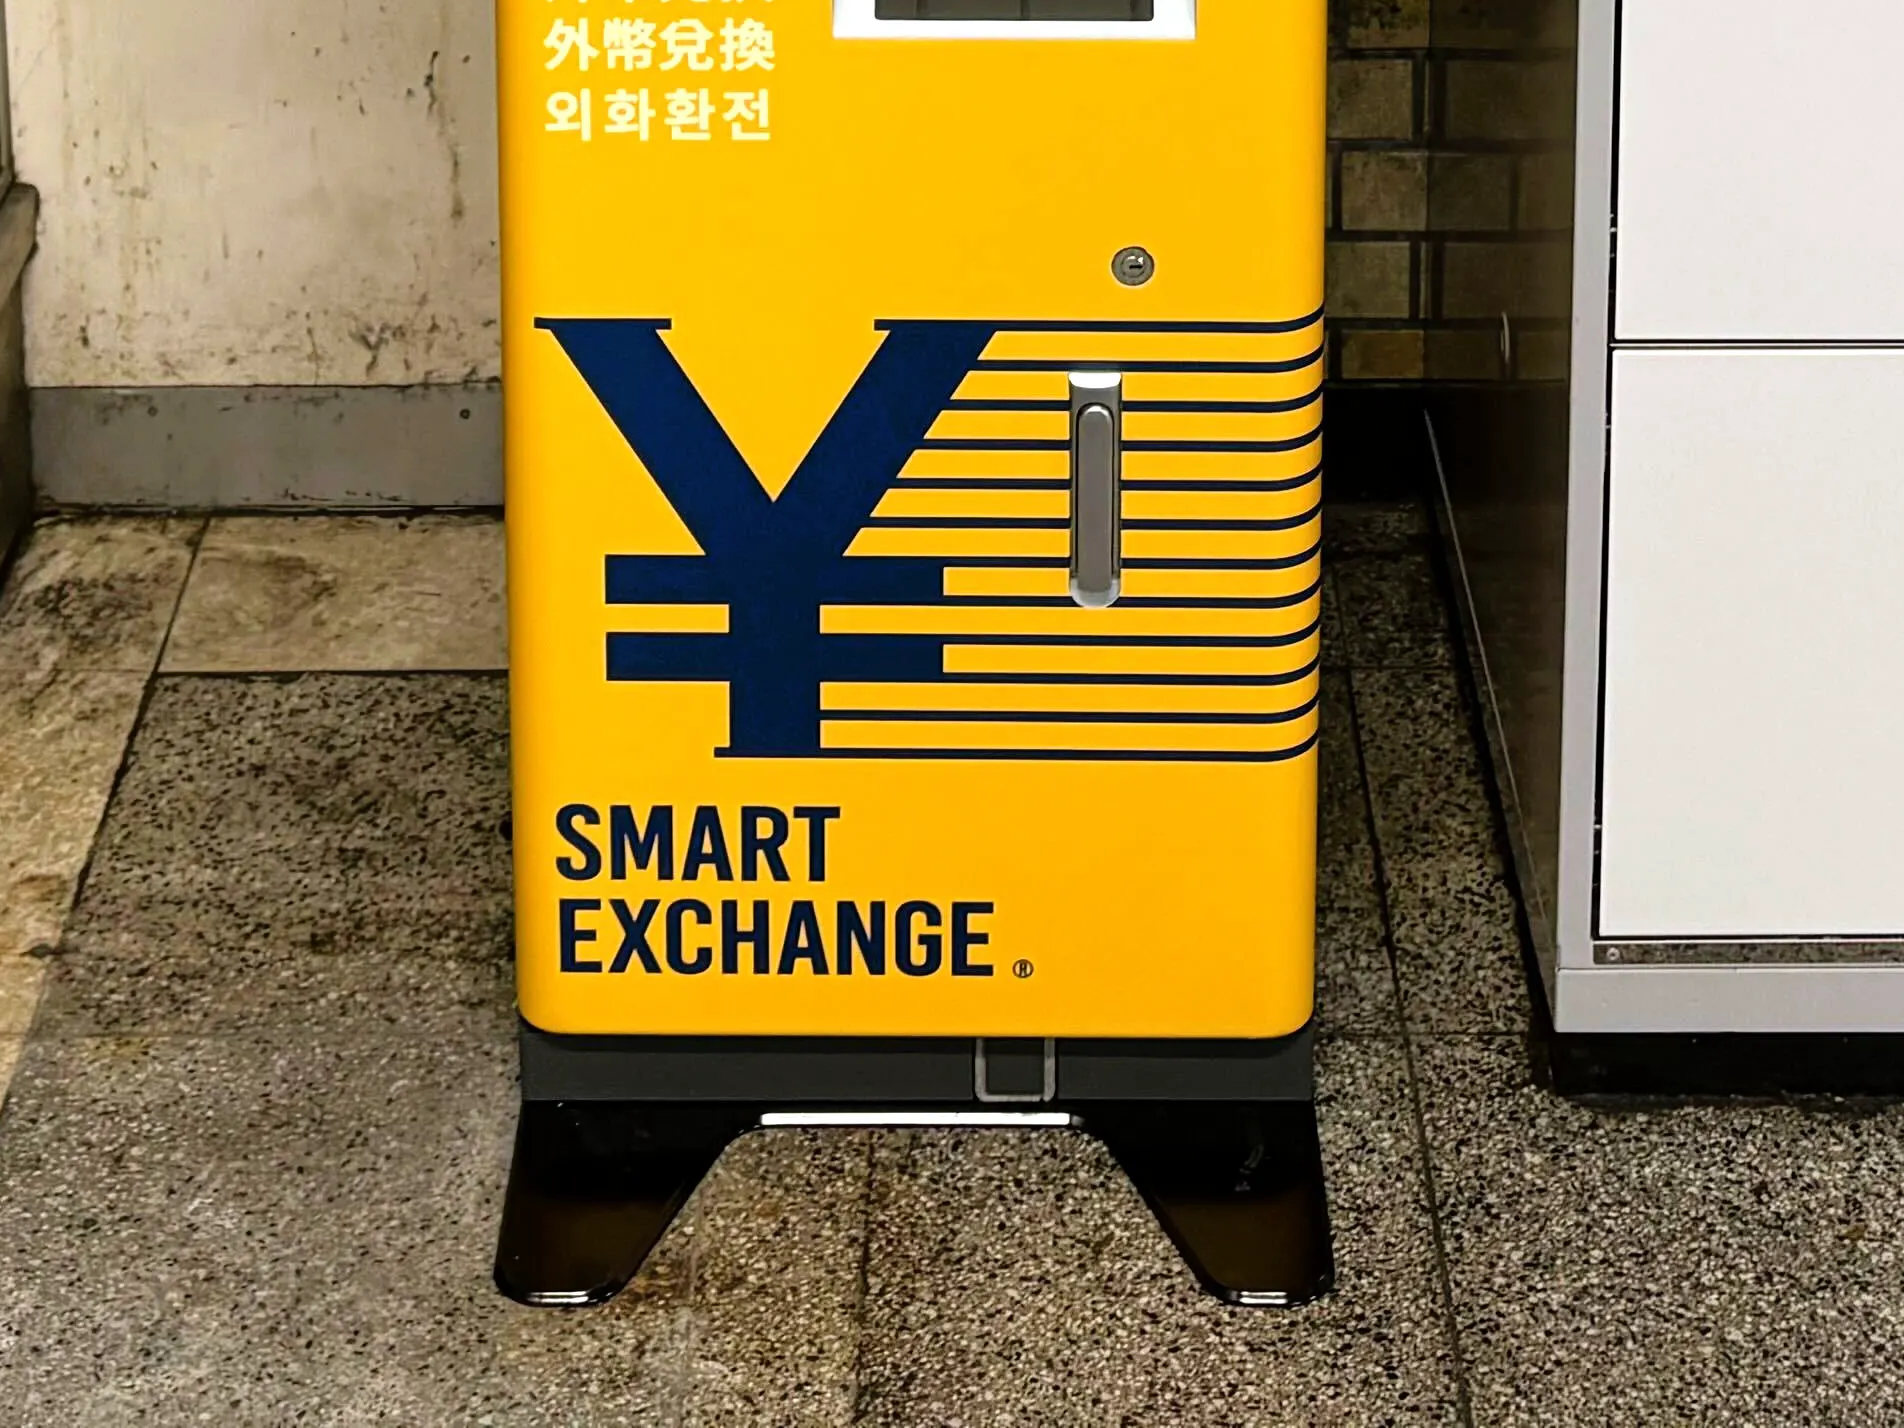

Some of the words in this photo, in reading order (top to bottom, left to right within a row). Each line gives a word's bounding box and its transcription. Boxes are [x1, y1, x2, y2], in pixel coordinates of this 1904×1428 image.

[543, 16, 775, 72] 外幣兌換
[544, 87, 771, 142] 외화환전
[555, 803, 841, 882] SMART
[559, 898, 994, 977] EXCHANGE
